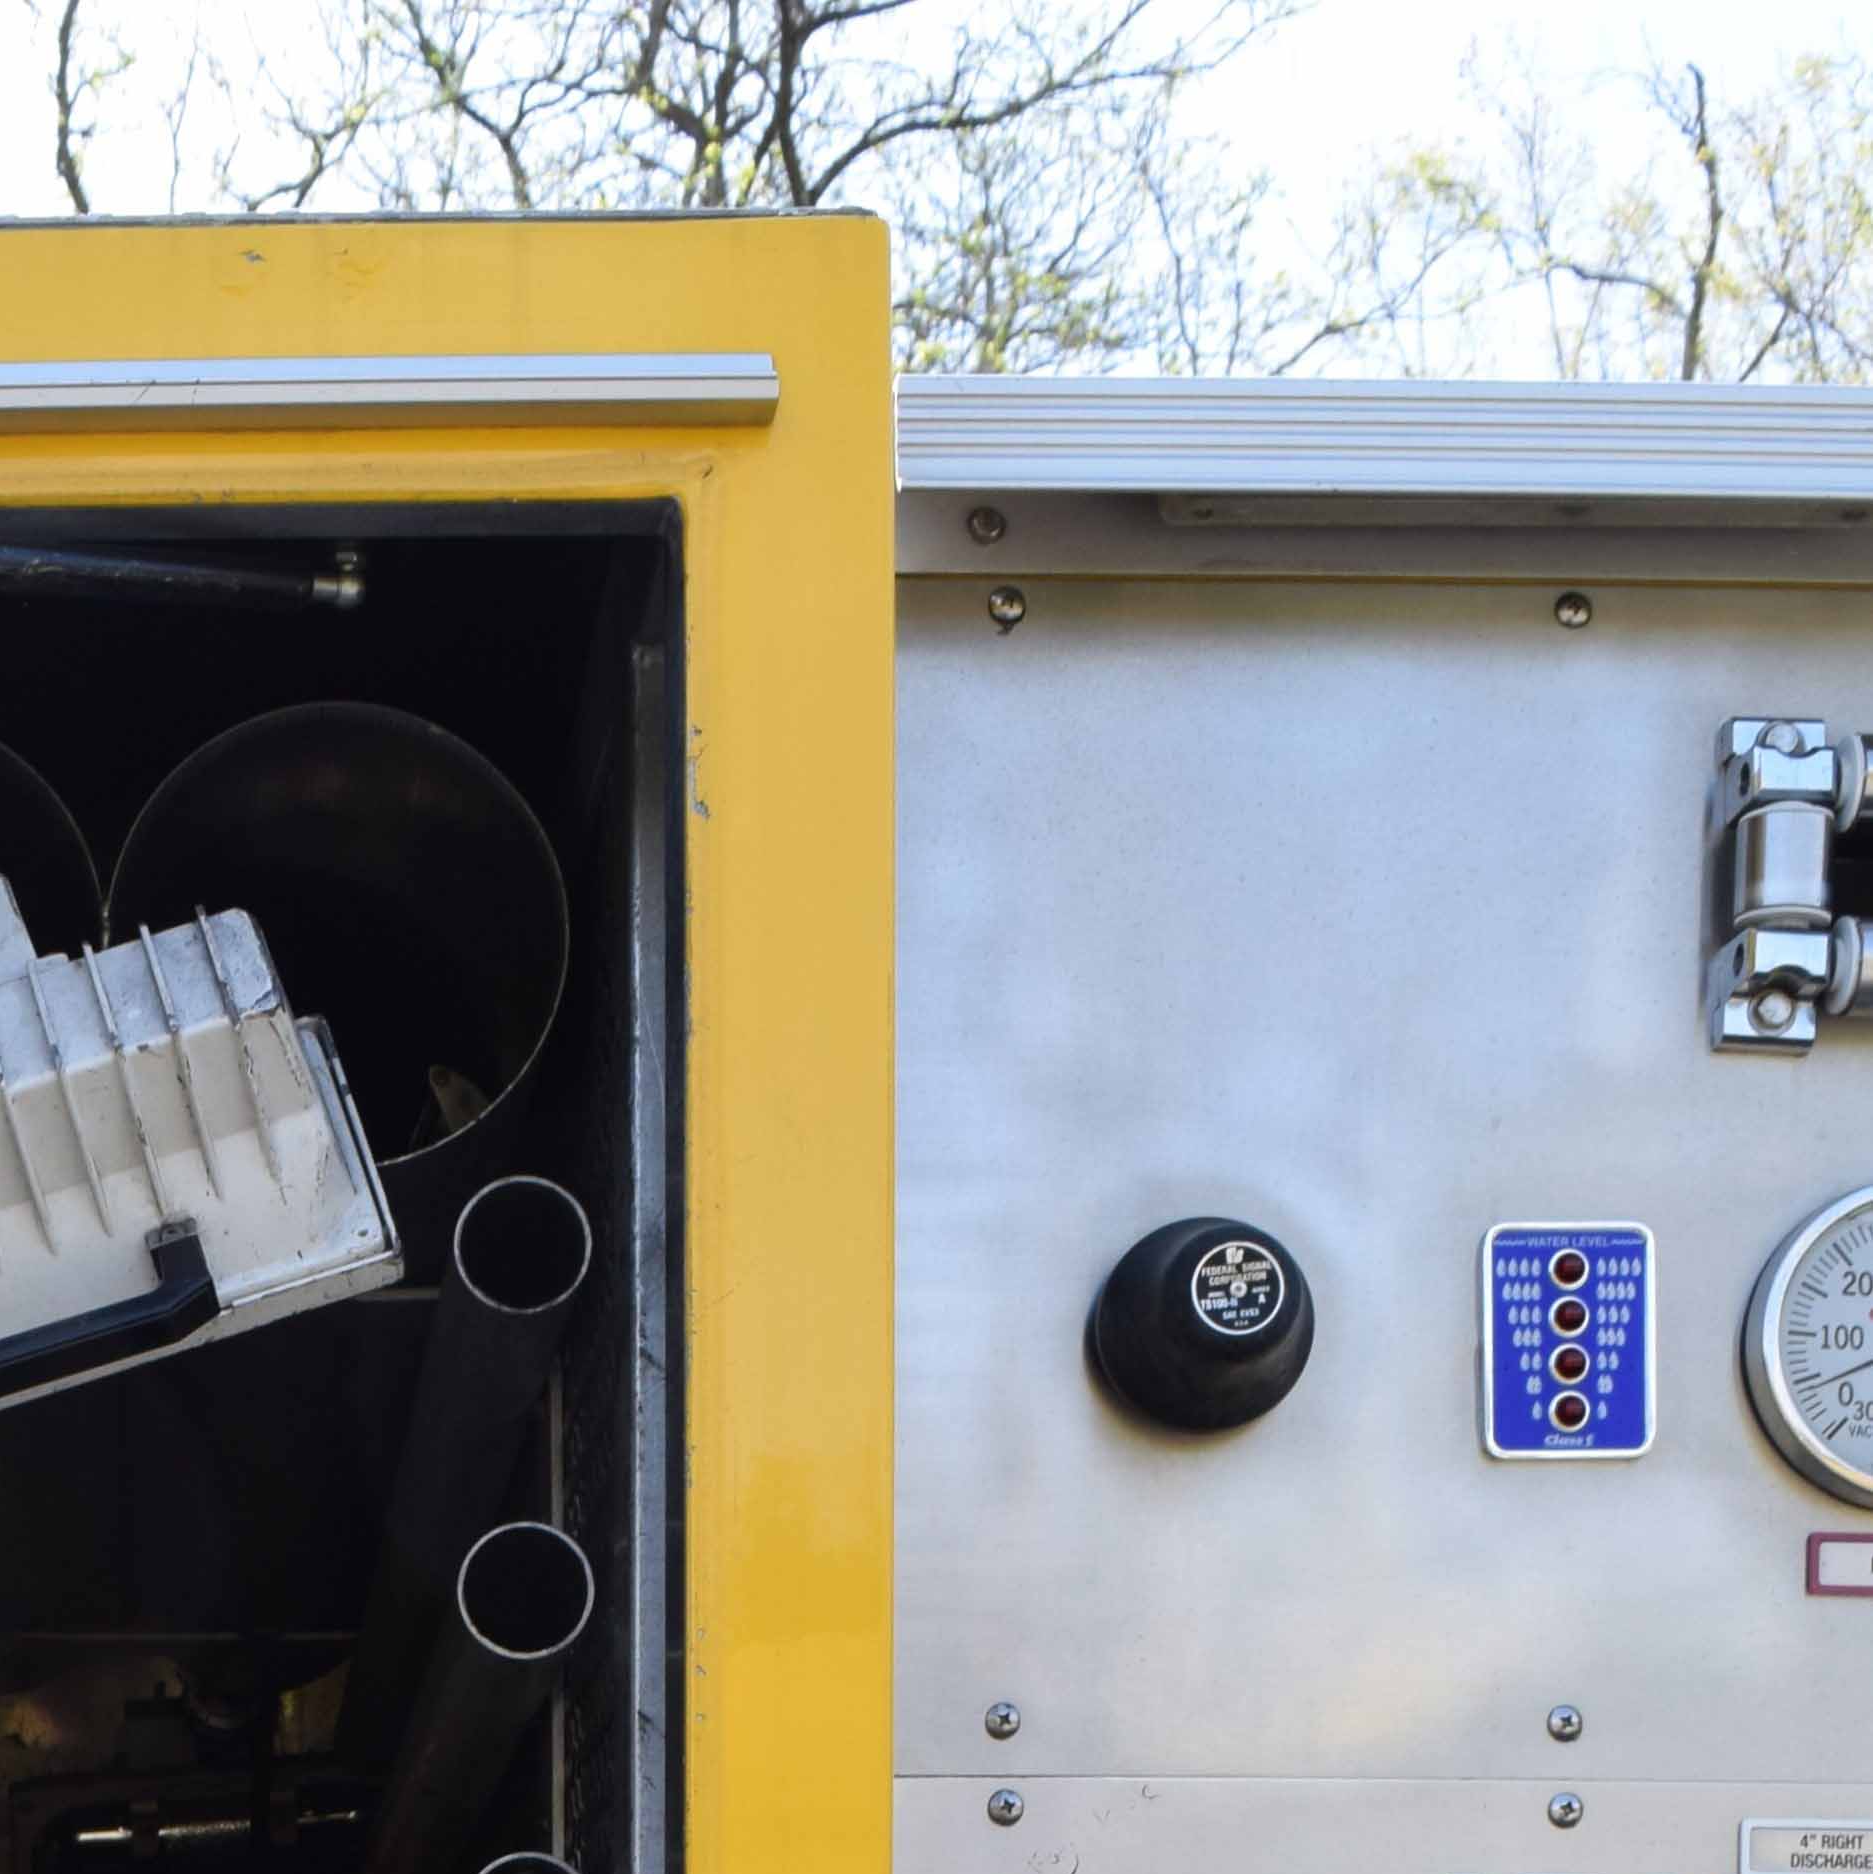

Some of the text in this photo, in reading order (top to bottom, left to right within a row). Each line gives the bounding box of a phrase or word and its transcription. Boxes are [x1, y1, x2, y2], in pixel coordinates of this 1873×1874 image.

[1527, 1237, 1609, 1247] WATER LEVEL
[1821, 1325, 1863, 1350] 100
[1838, 1381, 1853, 1407] 0
[1822, 1835, 1863, 1849] RIGHT
[1790, 1854, 1873, 1869] DISCHARGE
